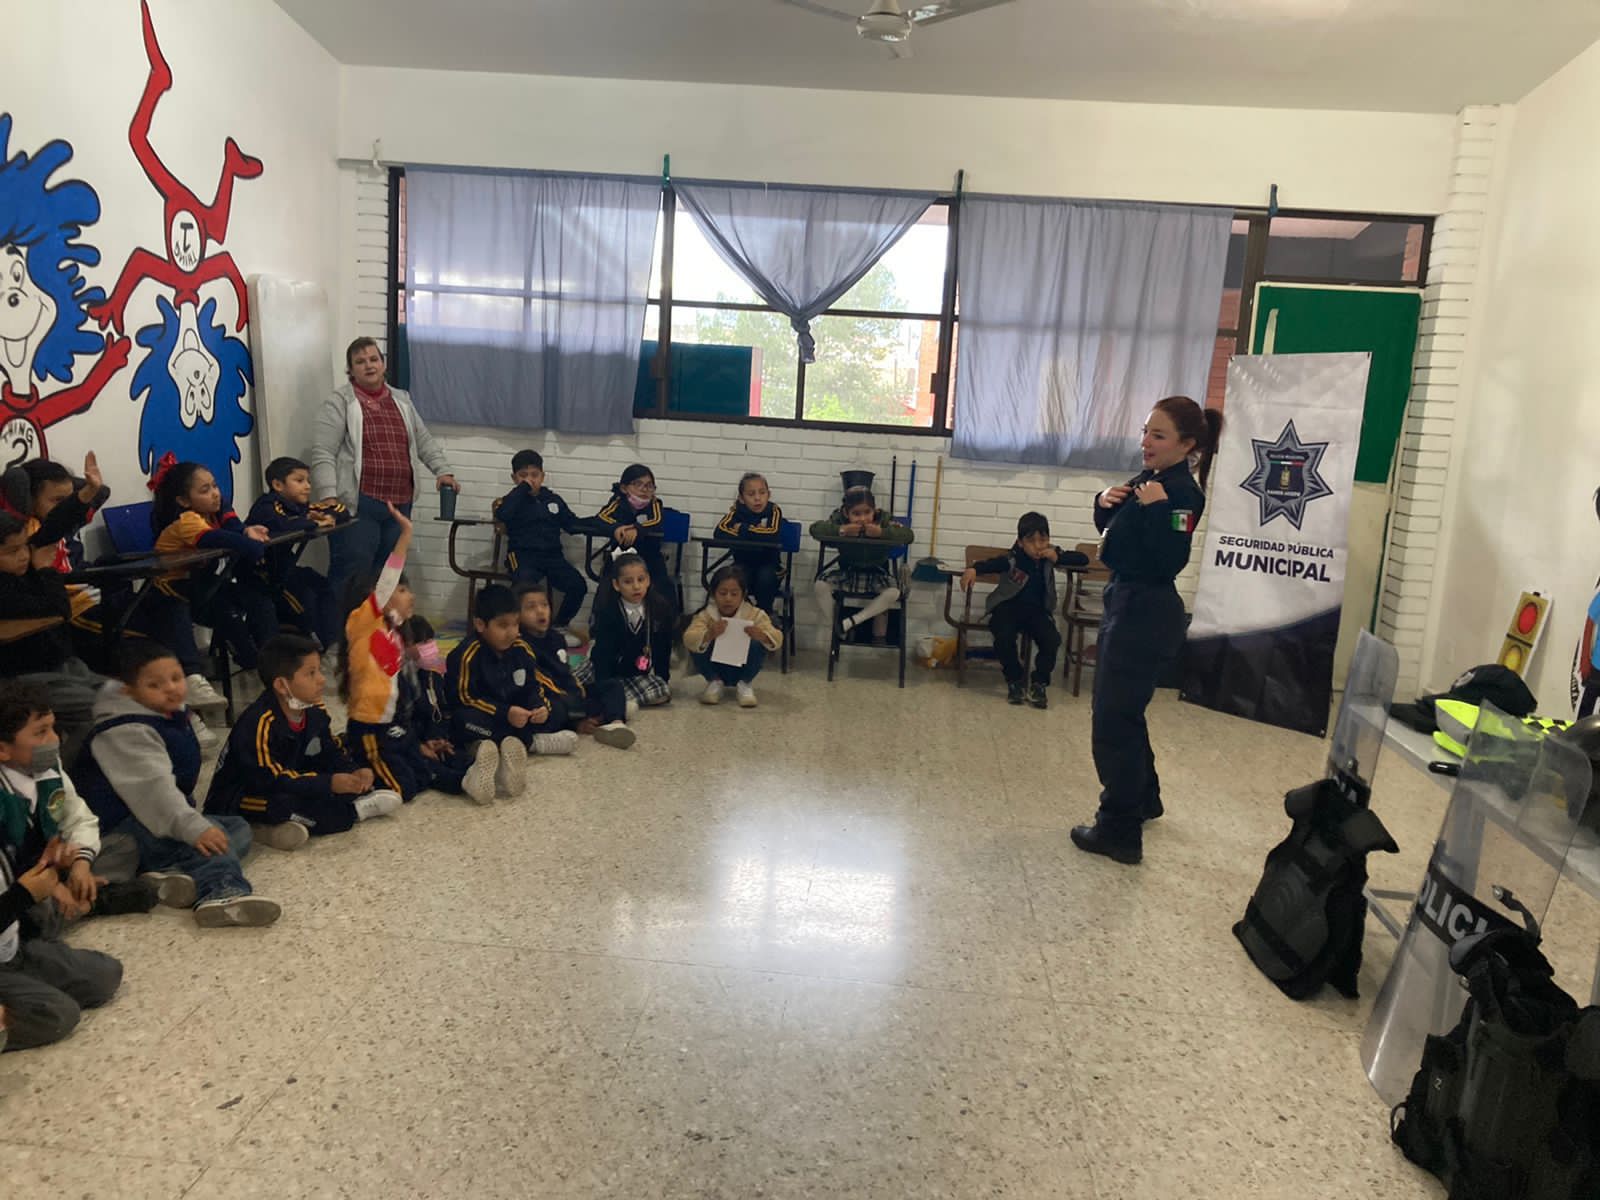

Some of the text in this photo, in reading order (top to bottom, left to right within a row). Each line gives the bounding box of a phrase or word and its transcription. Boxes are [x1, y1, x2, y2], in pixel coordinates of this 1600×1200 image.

[180, 222, 194, 253] 1
[5, 437, 28, 470] 2
[1218, 535, 1334, 559] SEGURIDAD PÚBLICA
[1214, 549, 1331, 583] MUNICIPAL
